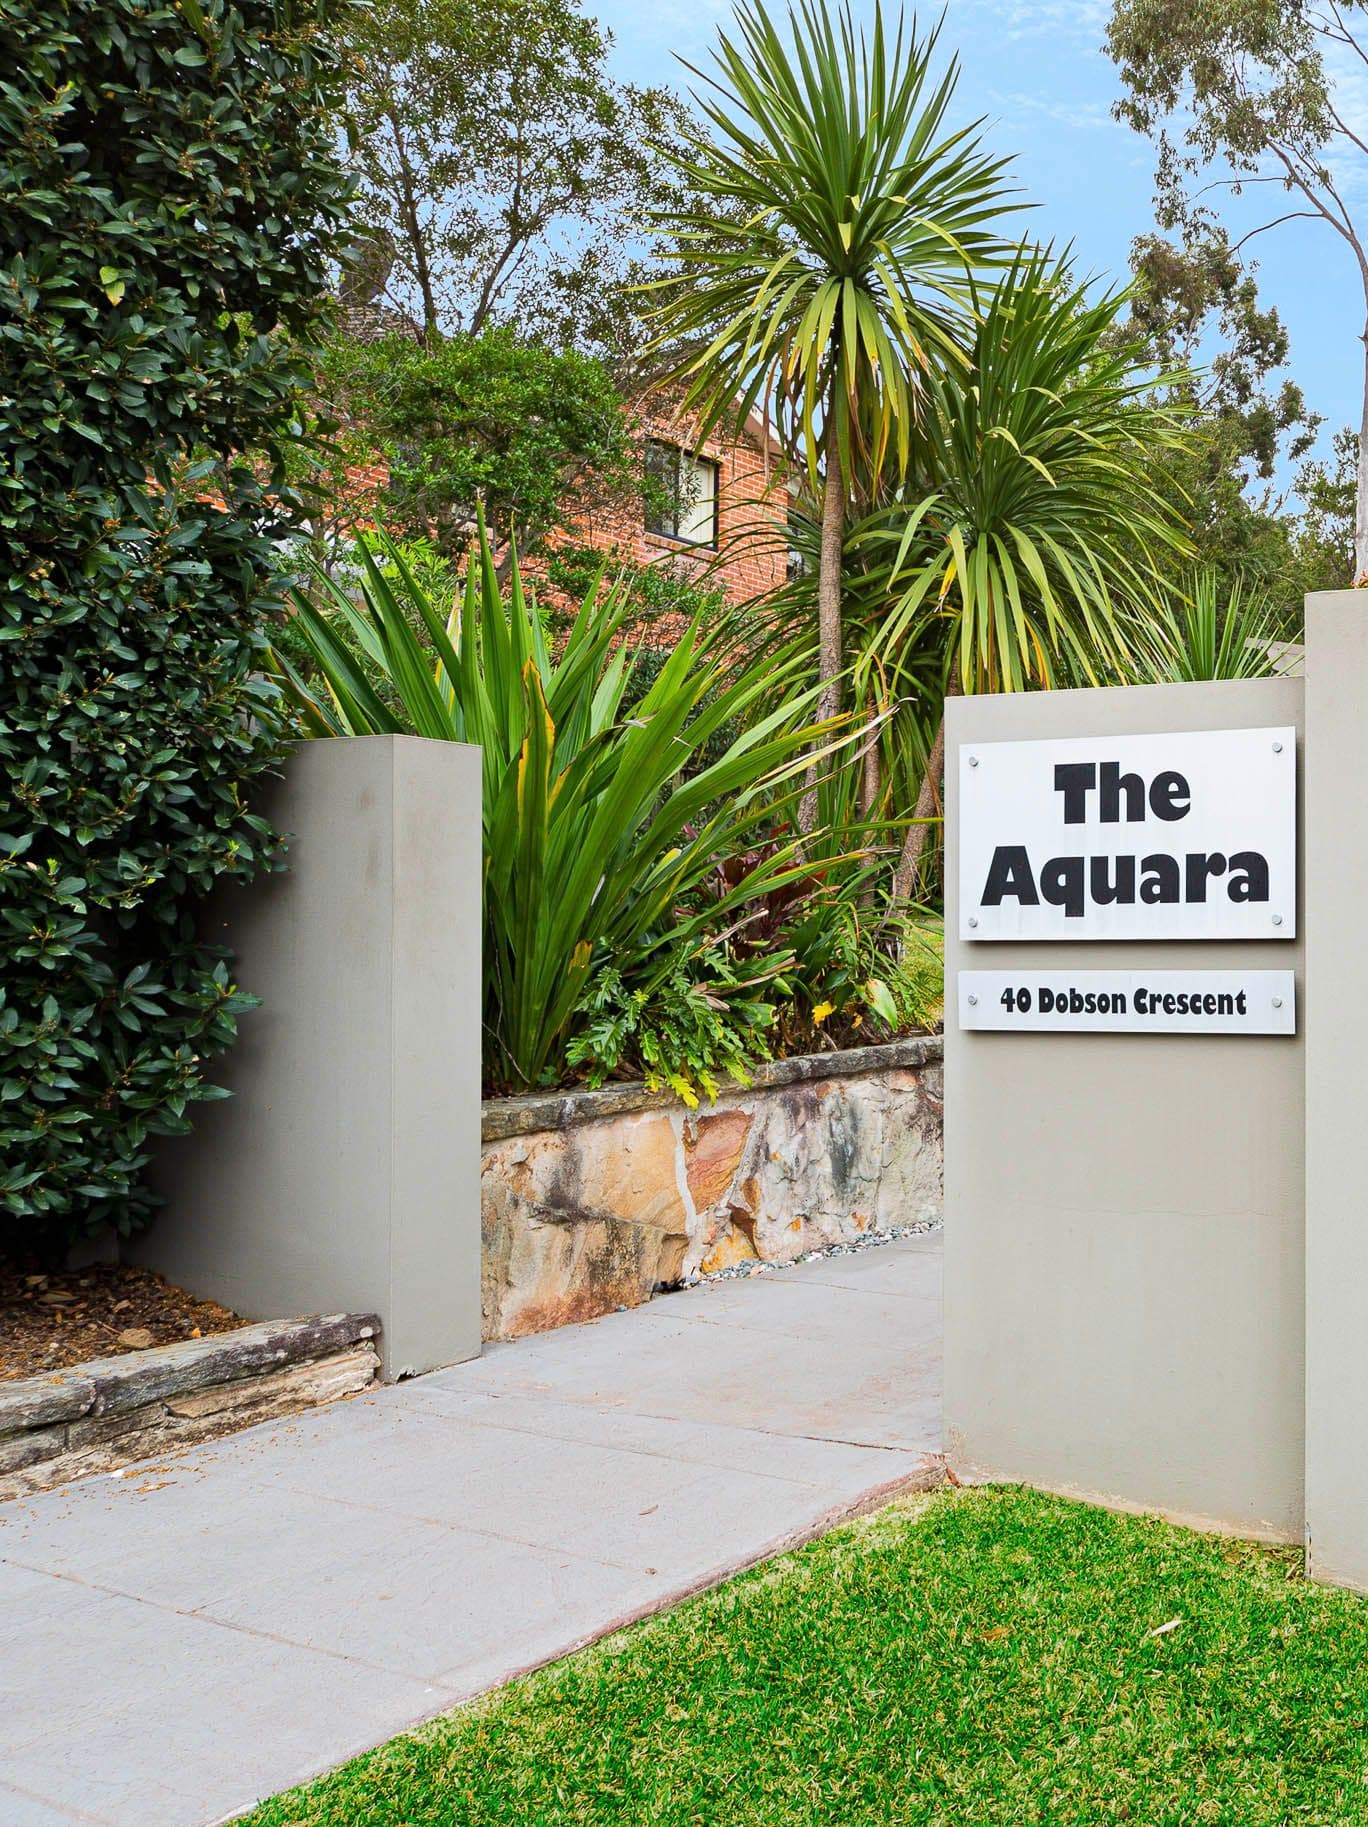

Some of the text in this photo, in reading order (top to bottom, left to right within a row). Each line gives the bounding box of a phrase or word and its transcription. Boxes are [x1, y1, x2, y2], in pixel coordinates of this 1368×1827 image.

[1054, 761, 1191, 825] The
[980, 845, 1270, 918] Aquara
[1000, 987, 1247, 1016] 40 Dobson Crescent
